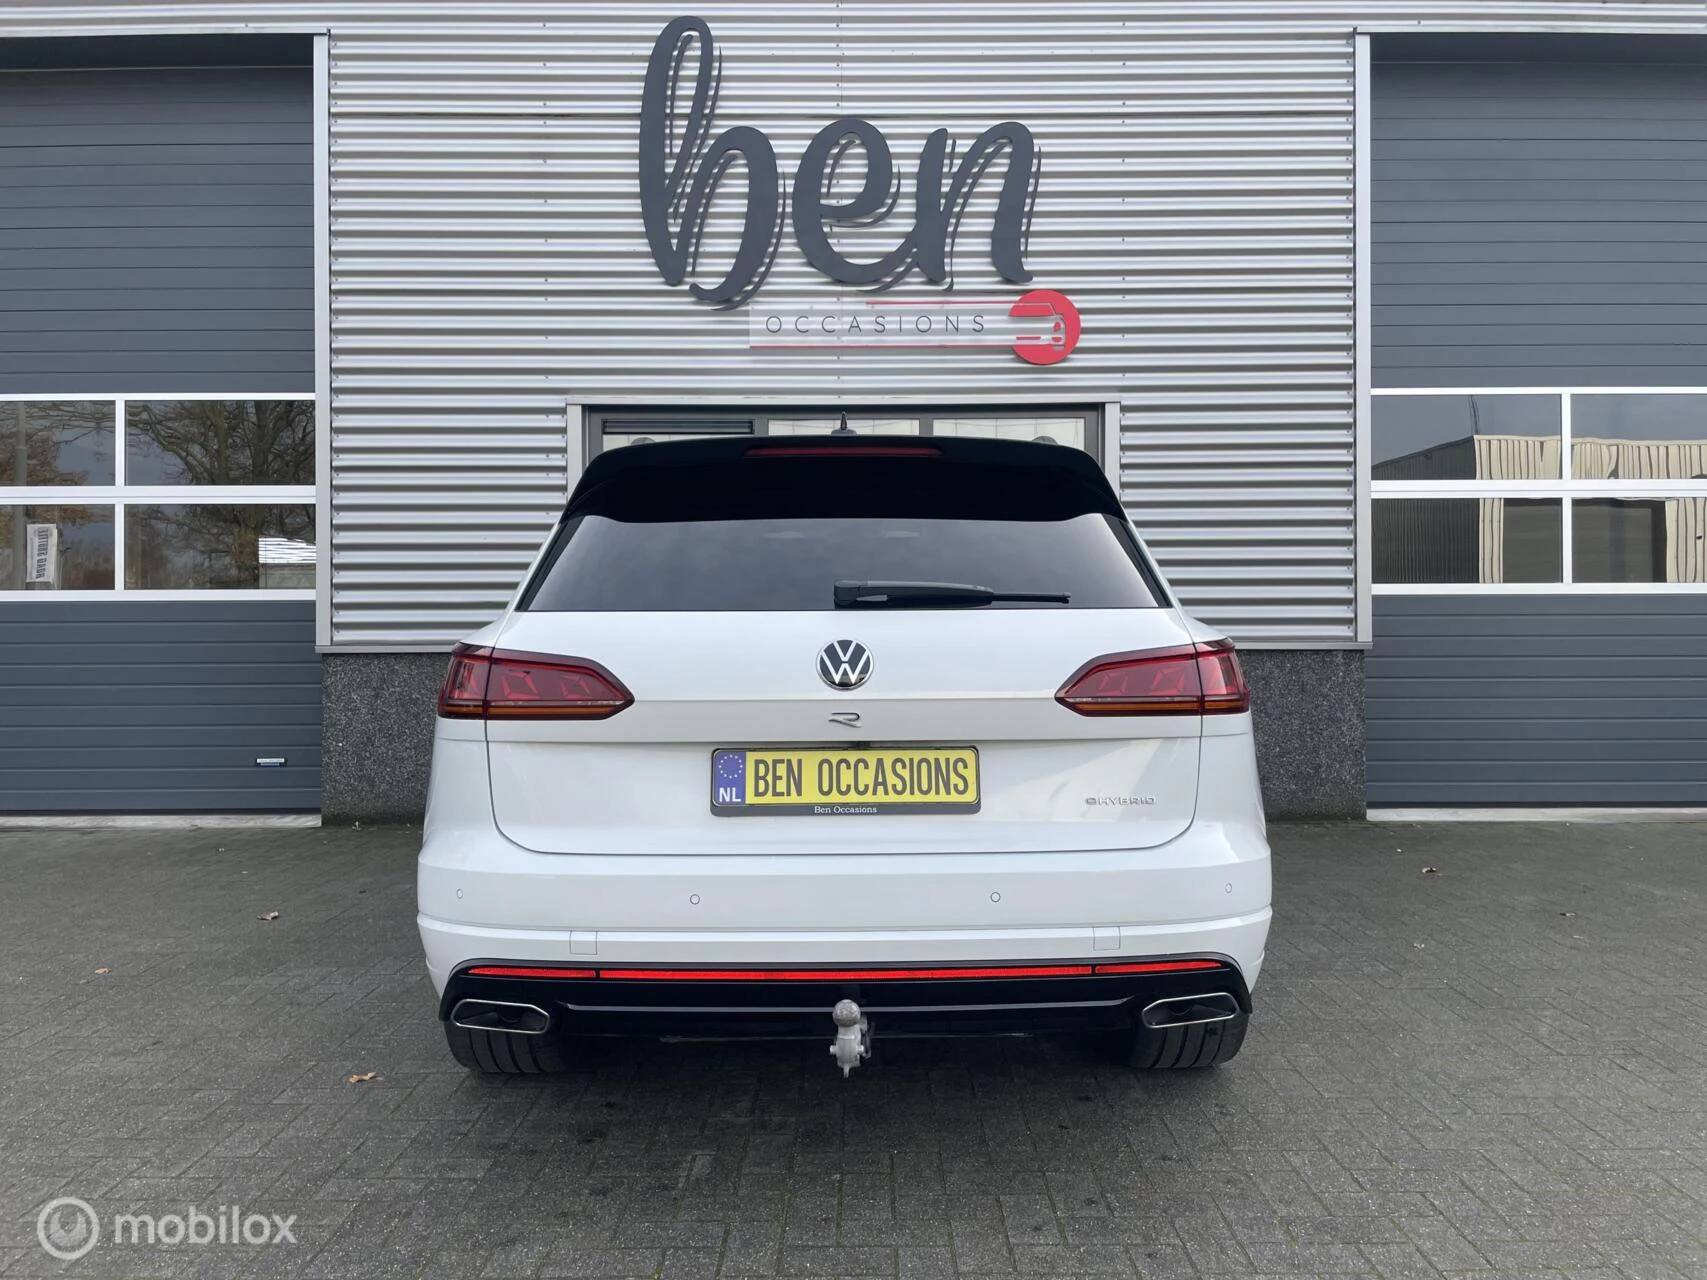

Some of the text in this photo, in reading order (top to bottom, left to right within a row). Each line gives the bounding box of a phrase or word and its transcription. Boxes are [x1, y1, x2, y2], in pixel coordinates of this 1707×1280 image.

[639, 15, 1041, 309] ben
[765, 315, 985, 334] OCCASIONS
[818, 640, 871, 688] VW
[754, 757, 969, 797] BEN OCCASIONS
[719, 787, 741, 803] NL
[814, 806, 877, 814] Ben Occasions
